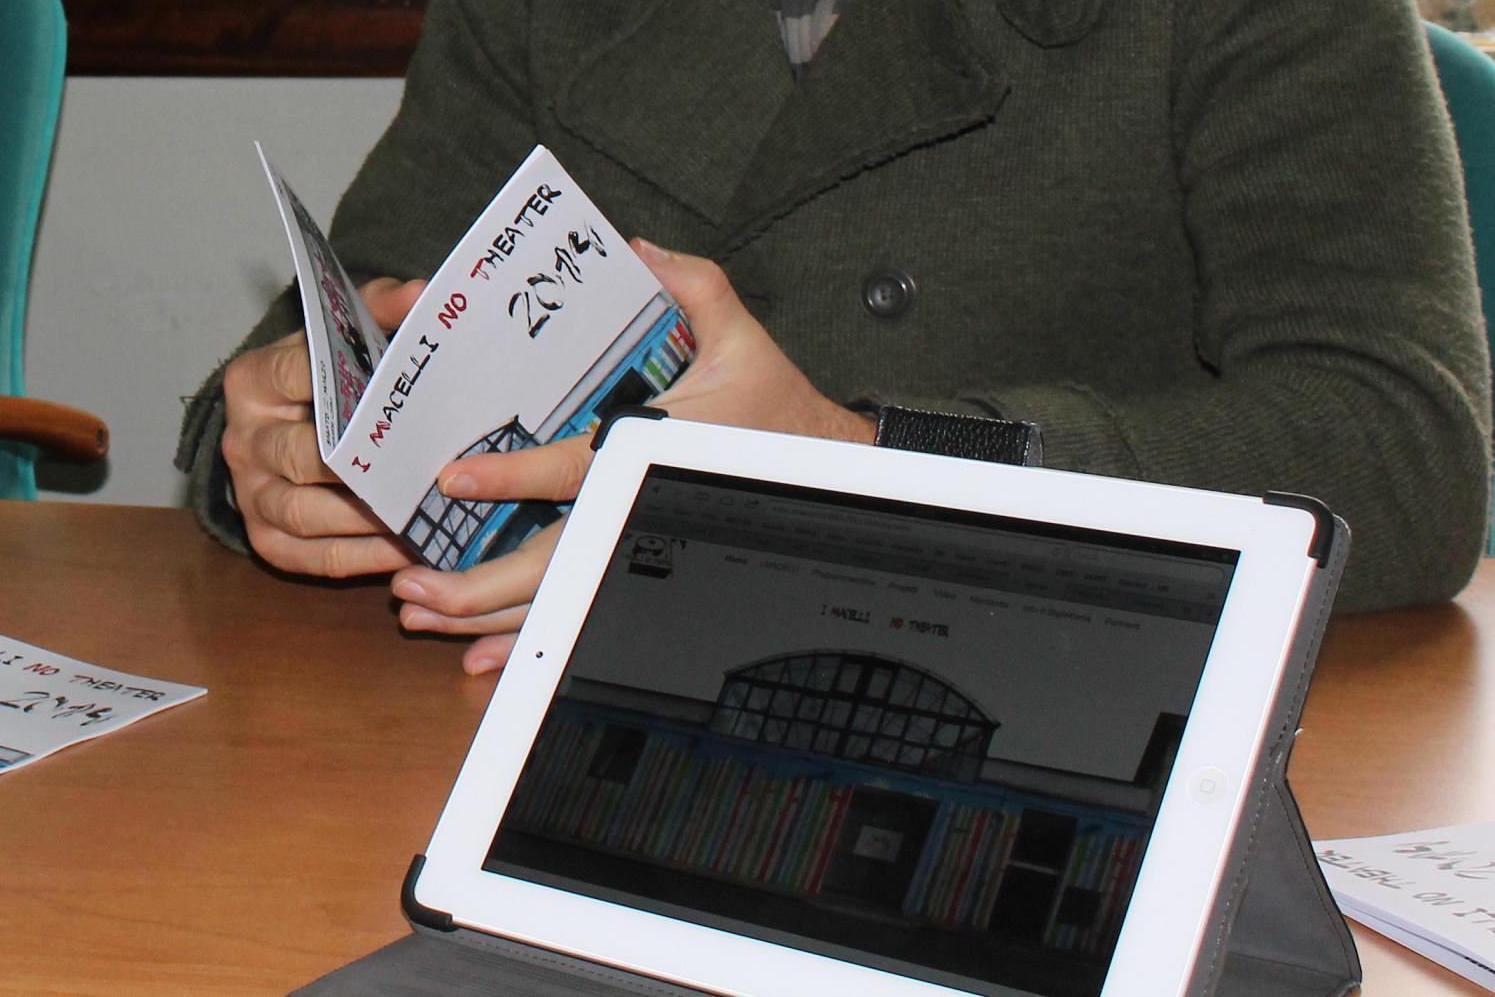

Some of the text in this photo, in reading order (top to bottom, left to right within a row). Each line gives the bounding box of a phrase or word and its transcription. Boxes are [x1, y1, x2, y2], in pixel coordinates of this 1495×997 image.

[352, 183, 562, 473] I MACELLI NO THEATER
[22, 662, 60, 676] NO
[69, 674, 166, 701] THEATER
[1412, 892, 1465, 907] NO
